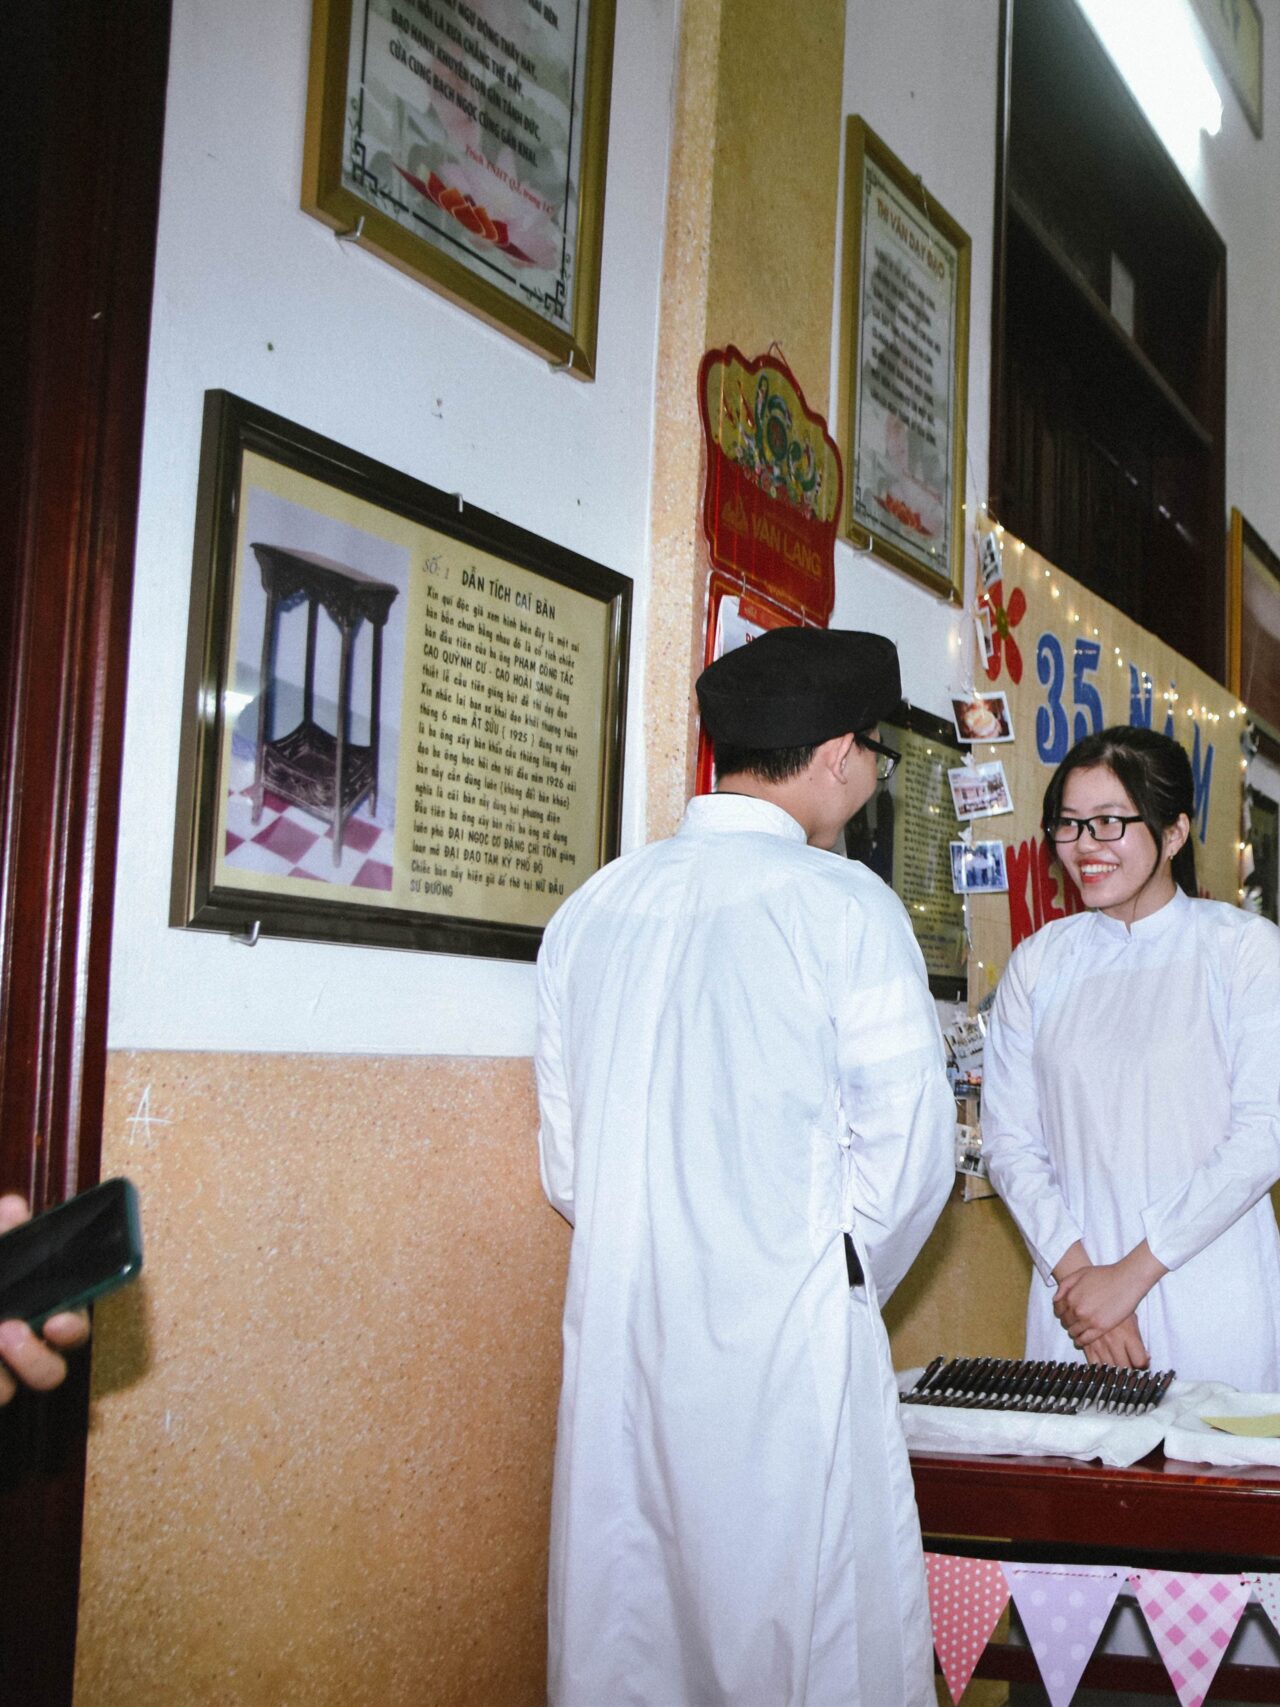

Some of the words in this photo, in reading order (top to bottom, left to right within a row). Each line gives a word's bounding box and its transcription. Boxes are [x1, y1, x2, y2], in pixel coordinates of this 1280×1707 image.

[490, 579, 511, 602] TÍCH
[423, 643, 439, 659] CAO
[495, 668, 510, 682] CAO
[1036, 632, 1104, 766] 35
[510, 730, 527, 743] 1925
[547, 776, 564, 789] 1926
